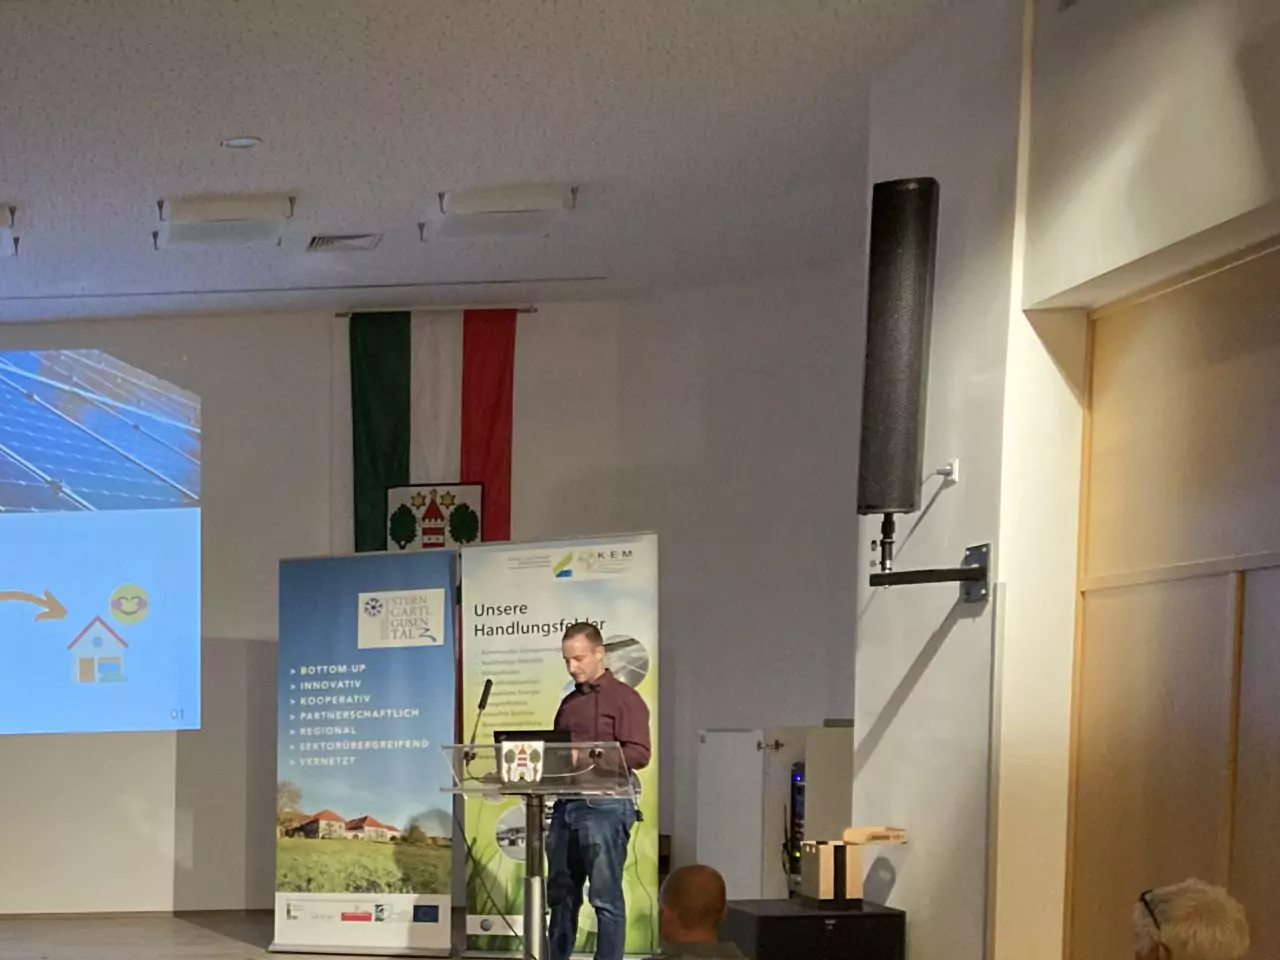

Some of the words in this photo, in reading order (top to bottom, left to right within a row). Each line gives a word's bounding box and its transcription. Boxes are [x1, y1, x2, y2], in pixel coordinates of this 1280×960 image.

[474, 603, 528, 617] Unsere
[474, 618, 606, 637] Handlungsfeer
[391, 629, 416, 640] TAL
[300, 664, 366, 676] BOTTOM-UP
[300, 680, 362, 691] INNOVATIV
[300, 695, 371, 706] KOOPERATIV
[300, 708, 420, 721] PARTNERSCHAFTLICH
[300, 726, 357, 736] REGIONAL
[300, 738, 430, 751] SEKTORÜBERGREIFEND
[300, 757, 356, 767] VERNETZT
